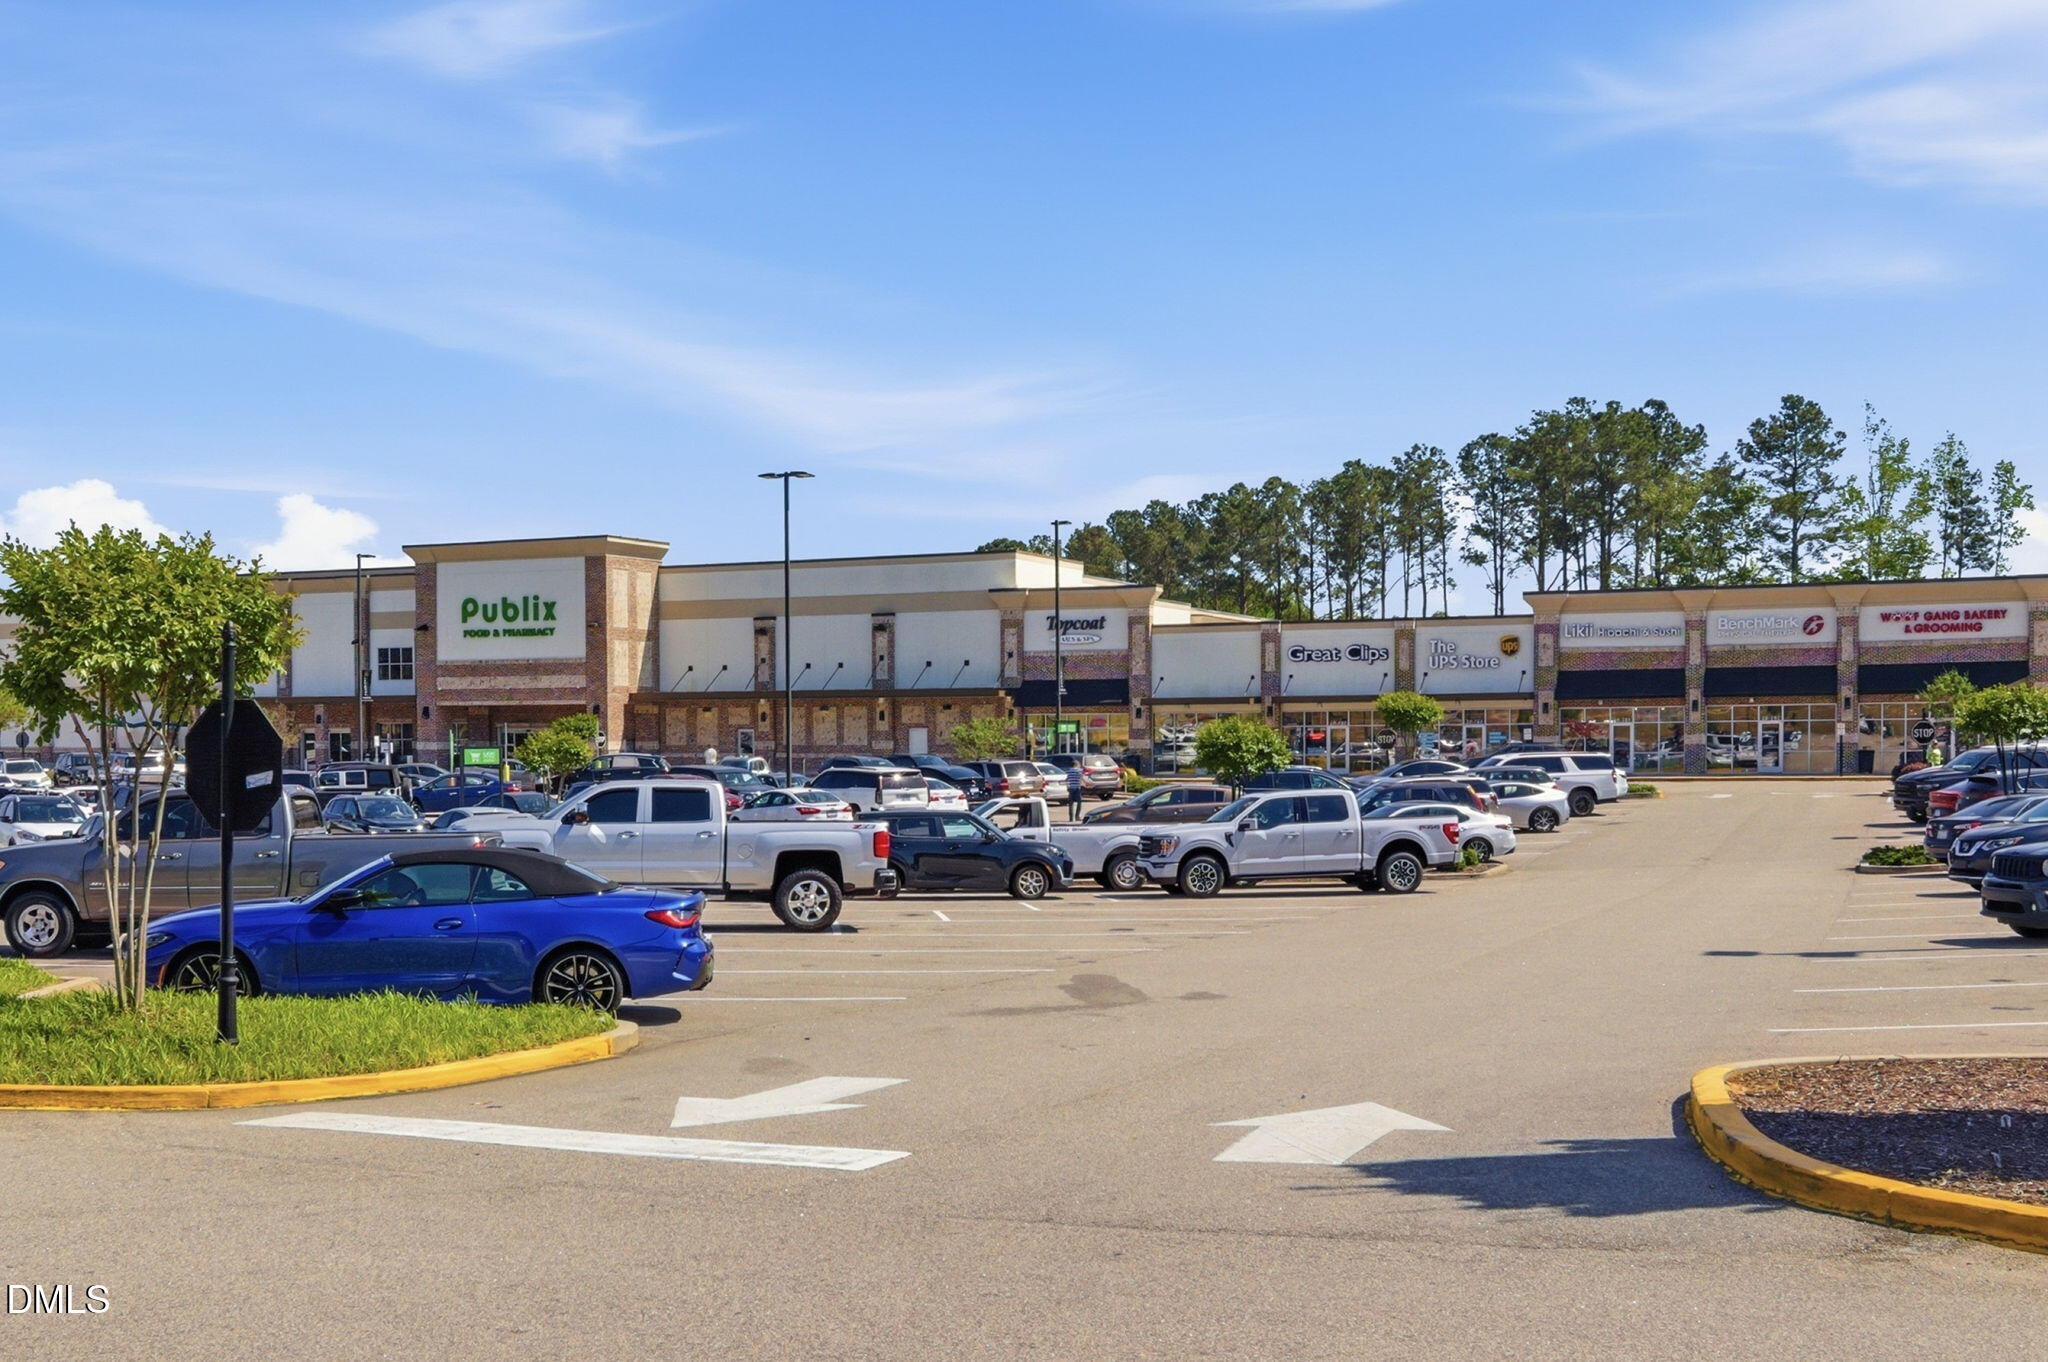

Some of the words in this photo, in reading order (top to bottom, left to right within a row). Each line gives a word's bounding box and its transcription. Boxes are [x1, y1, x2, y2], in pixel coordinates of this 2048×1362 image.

[461, 595, 557, 623] Publix
[1924, 610, 1960, 621] GANG
[1964, 609, 2008, 620] BAKERY
[1046, 615, 1106, 635] Topcoat
[1718, 616, 1799, 630] BenchMark
[1904, 624, 1912, 633] &
[1914, 622, 1983, 633] GROOMING
[463, 629, 490, 638] FOOD
[493, 629, 500, 637] &
[503, 627, 555, 637] PHARMACY
[1564, 624, 1593, 638] Likii
[1653, 626, 1681, 637] Sushi
[1429, 639, 1456, 653] The
[1502, 642, 1518, 654] ups
[1287, 645, 1341, 662] Great
[1345, 644, 1389, 665] Clips
[1429, 655, 1458, 670] UPS
[1461, 654, 1500, 669] Store
[1377, 734, 1395, 744] STOP
[1914, 728, 1934, 738] STOP
